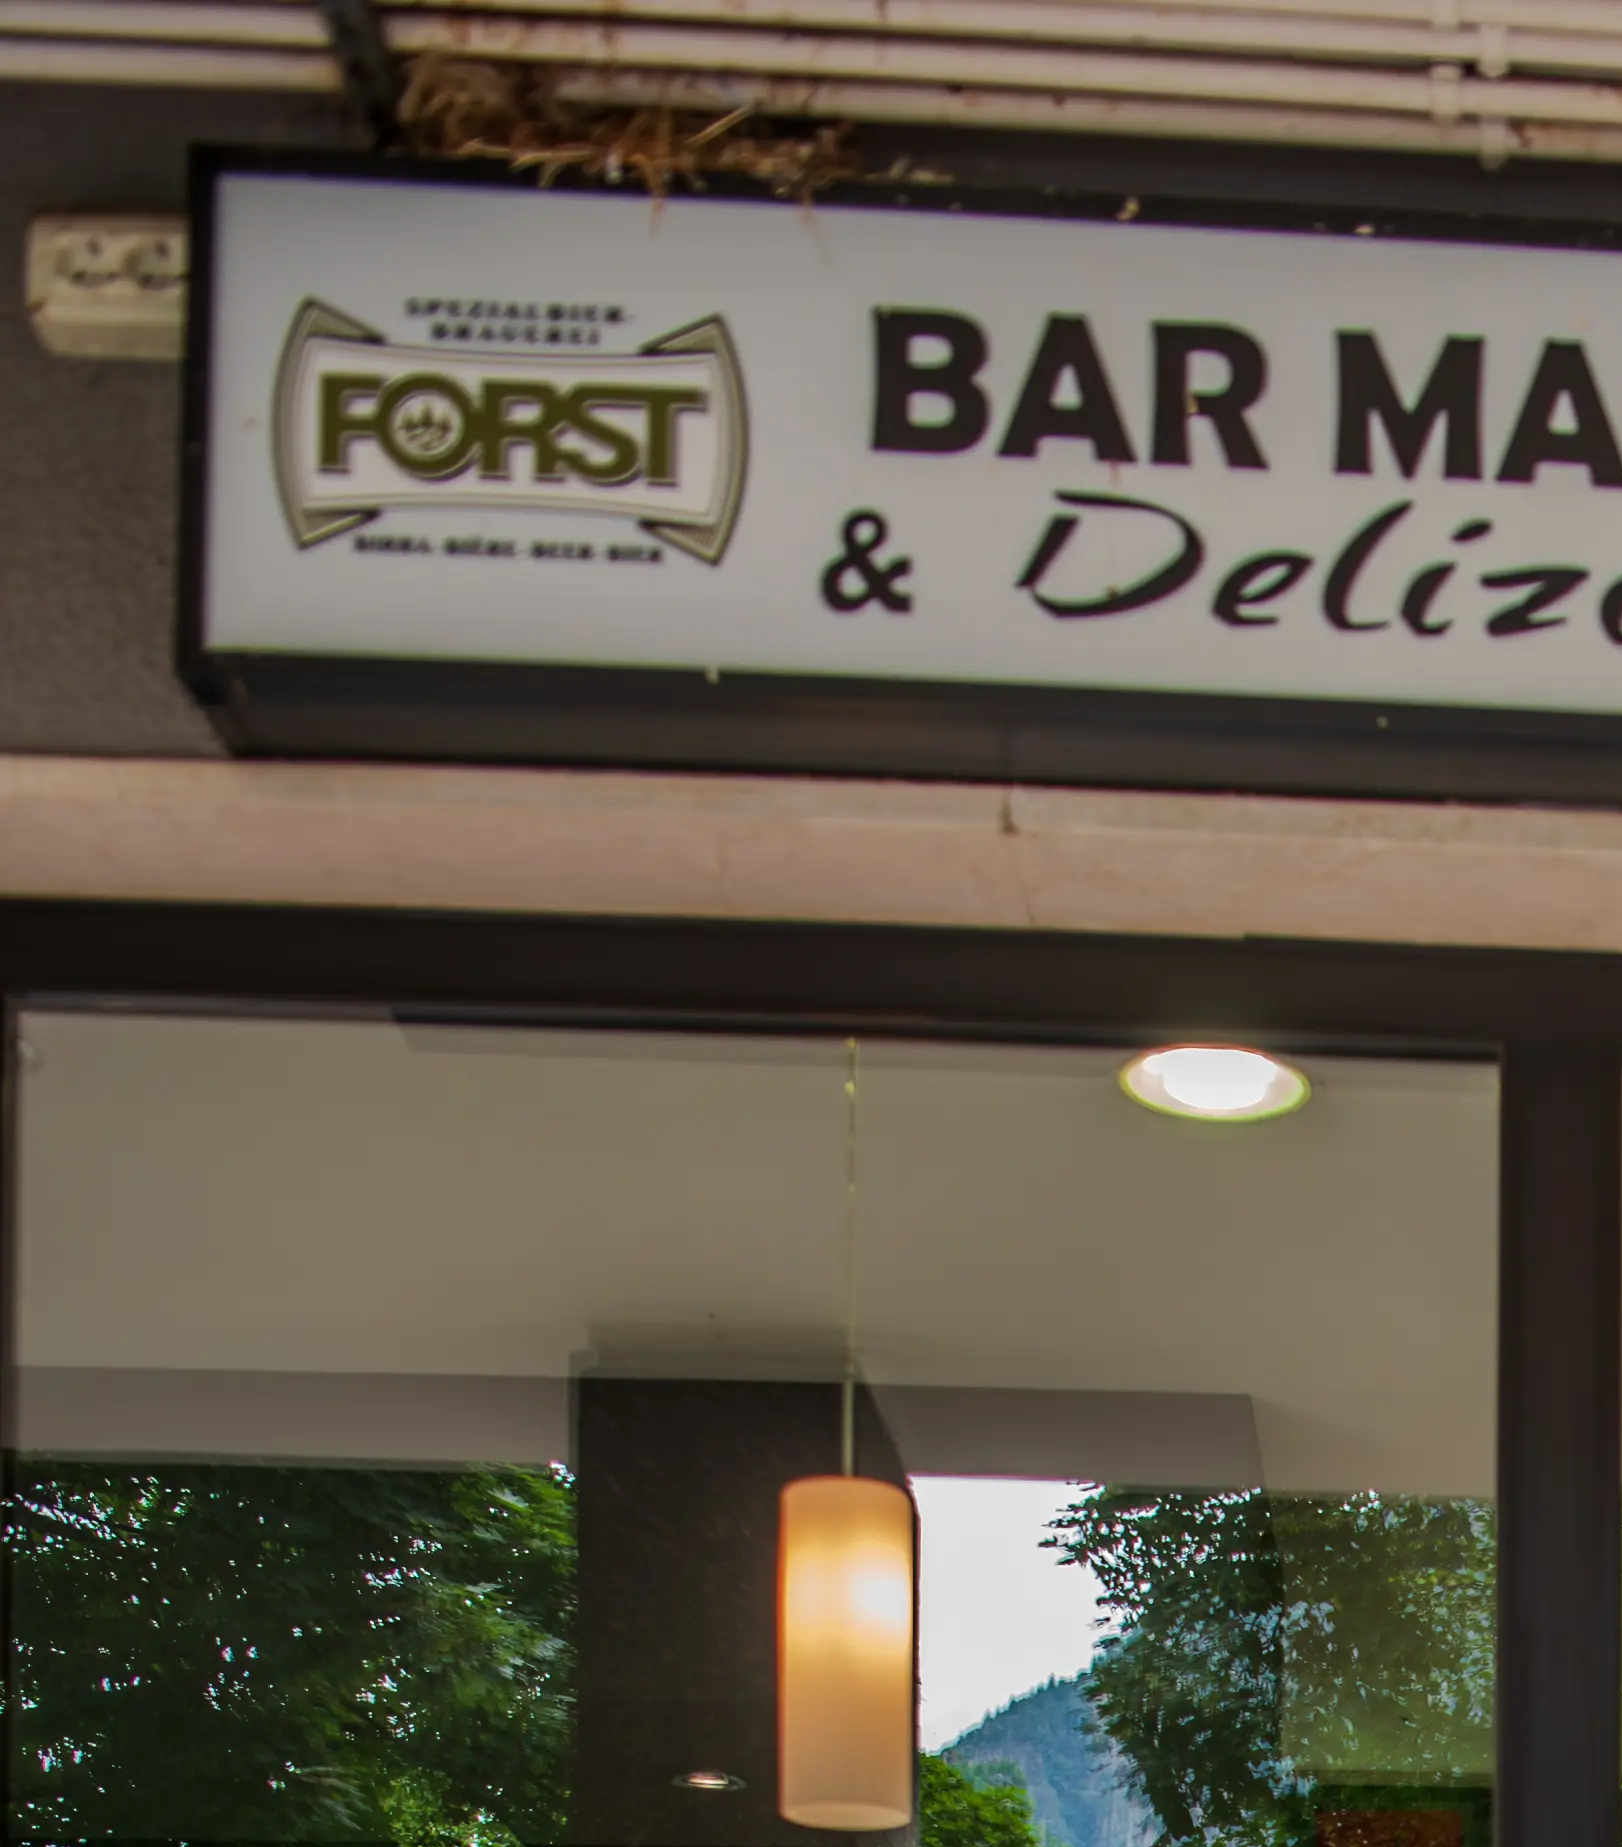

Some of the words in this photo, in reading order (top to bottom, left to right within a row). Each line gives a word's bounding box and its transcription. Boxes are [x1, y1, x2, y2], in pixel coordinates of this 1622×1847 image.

[317, 371, 710, 488] FORST
[870, 304, 1269, 471] BAR
[819, 508, 913, 615] &
